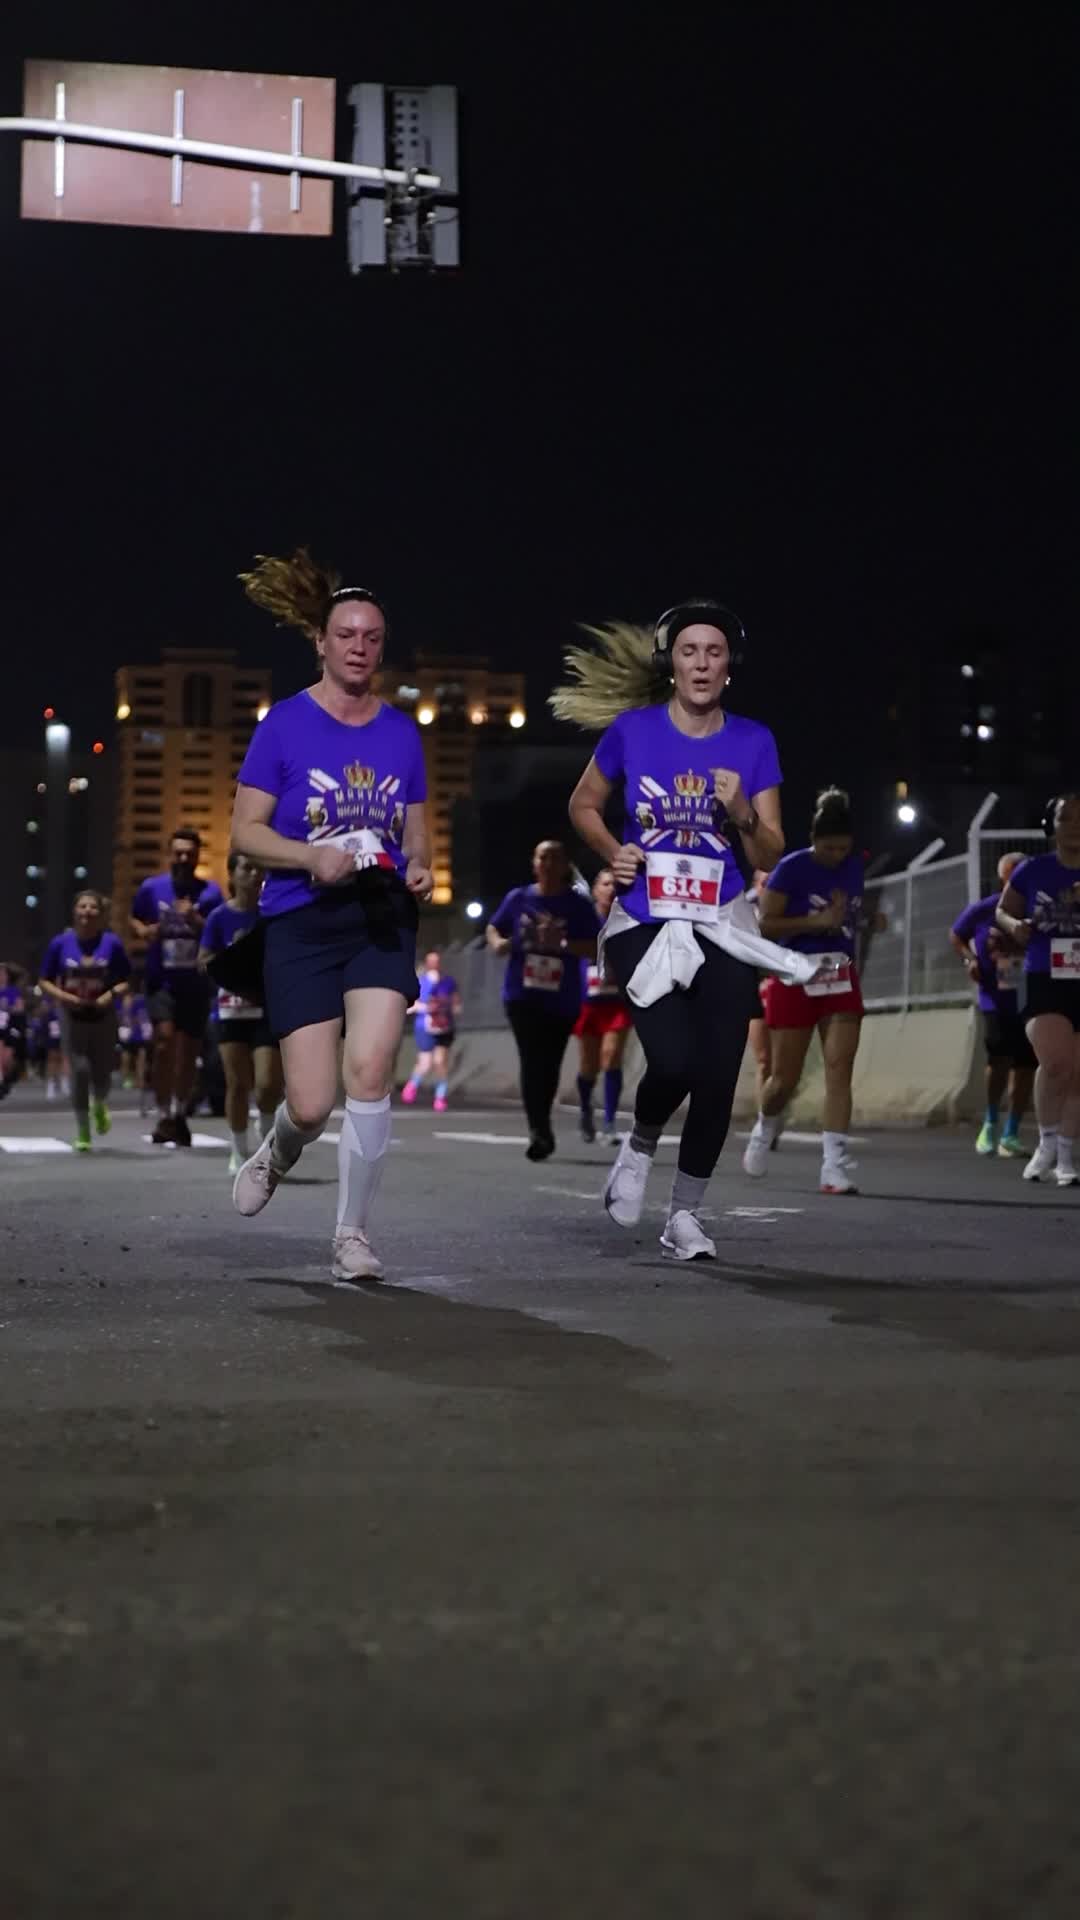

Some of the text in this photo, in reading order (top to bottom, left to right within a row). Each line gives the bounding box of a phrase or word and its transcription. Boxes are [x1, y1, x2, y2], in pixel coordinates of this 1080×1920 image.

[337, 805, 365, 818] NIGHT
[664, 811, 691, 823] NIGHT
[661, 875, 703, 898] 614
